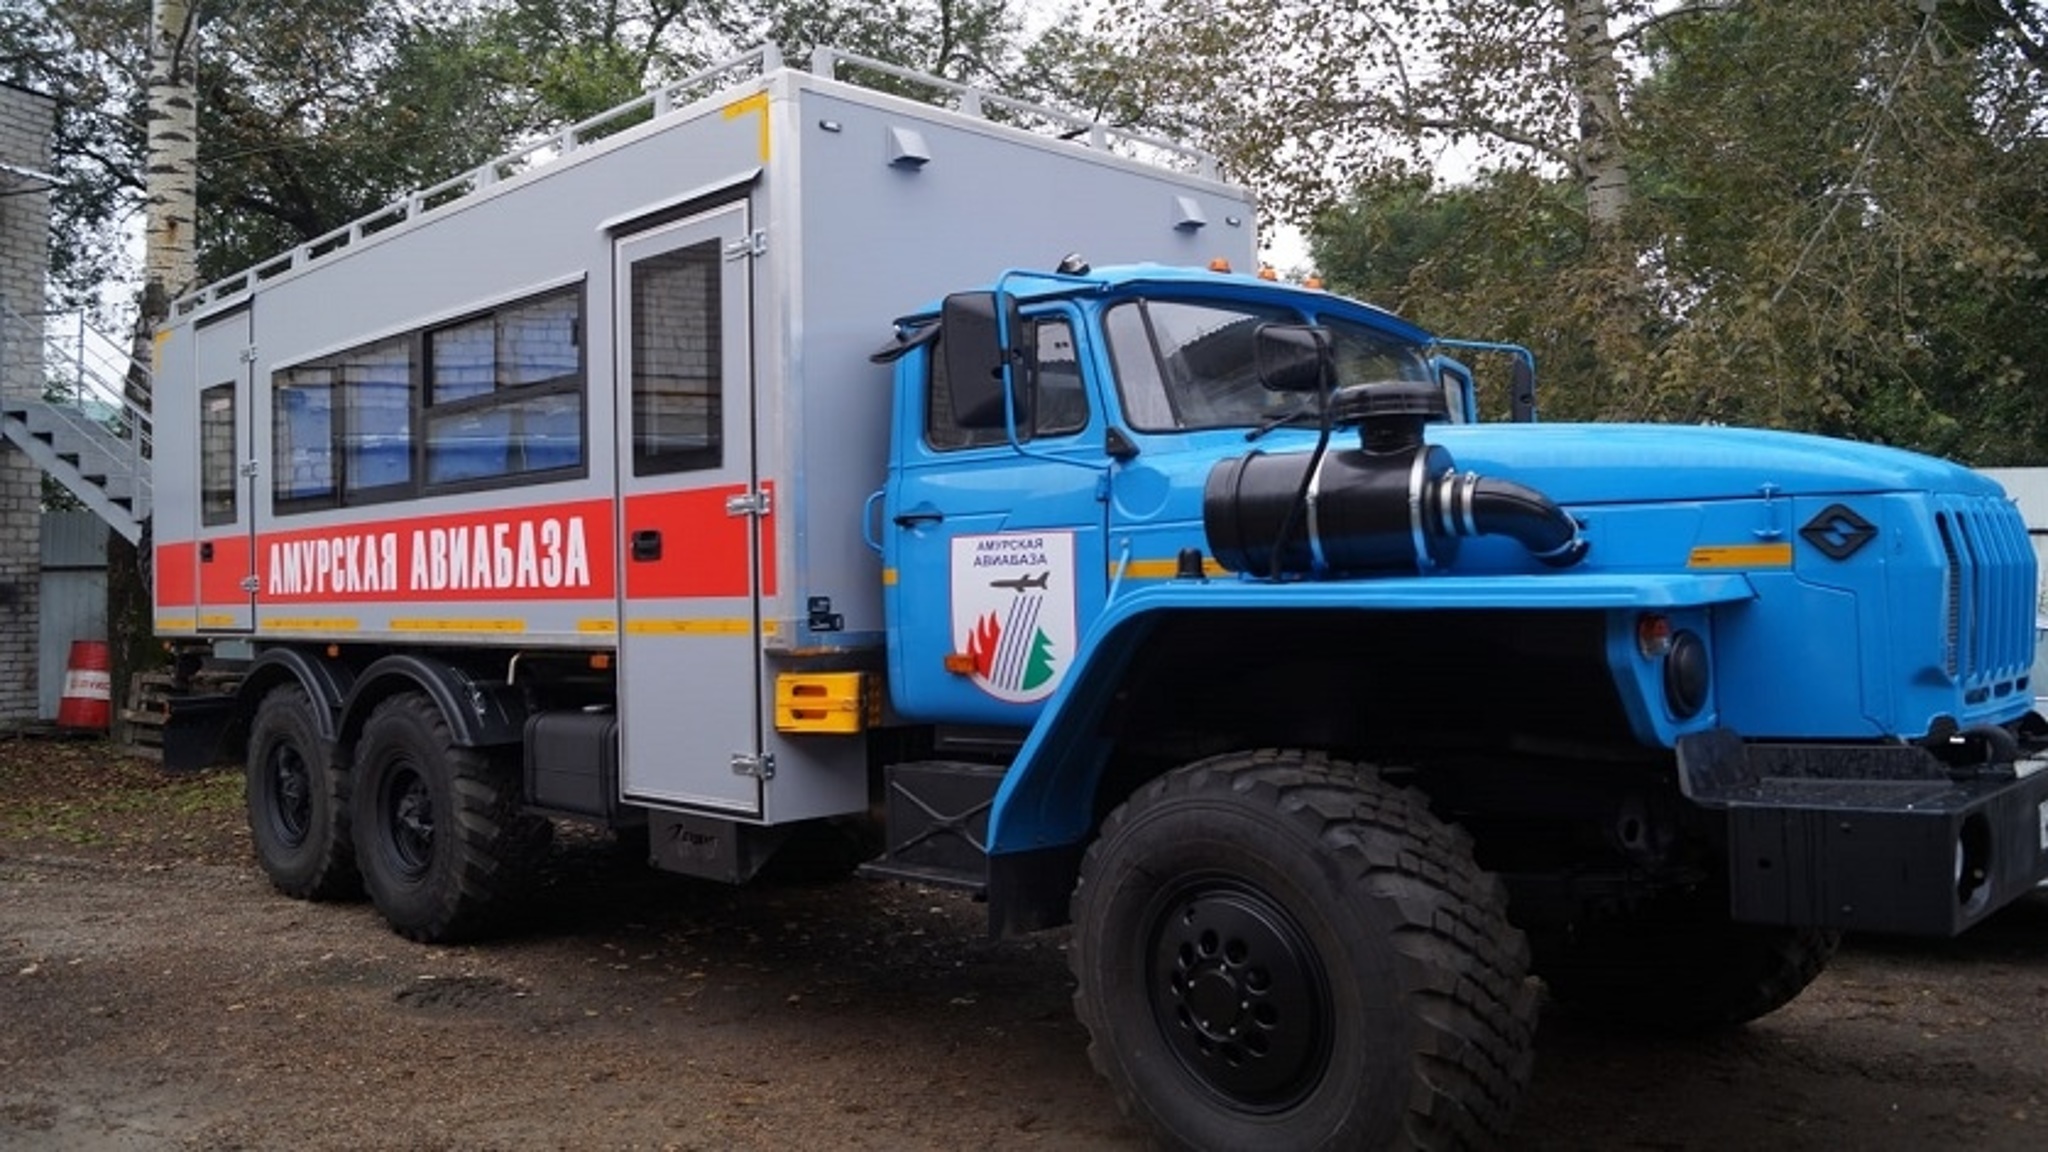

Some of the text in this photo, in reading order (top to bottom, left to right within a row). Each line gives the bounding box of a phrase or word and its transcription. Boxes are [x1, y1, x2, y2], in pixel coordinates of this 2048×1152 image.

[977, 538, 1043, 551] АМУРСКАЯ
[268, 516, 590, 595] АМУРСКАЯ АВИАБАЗА
[973, 553, 1047, 567] АВИАБАЗА
